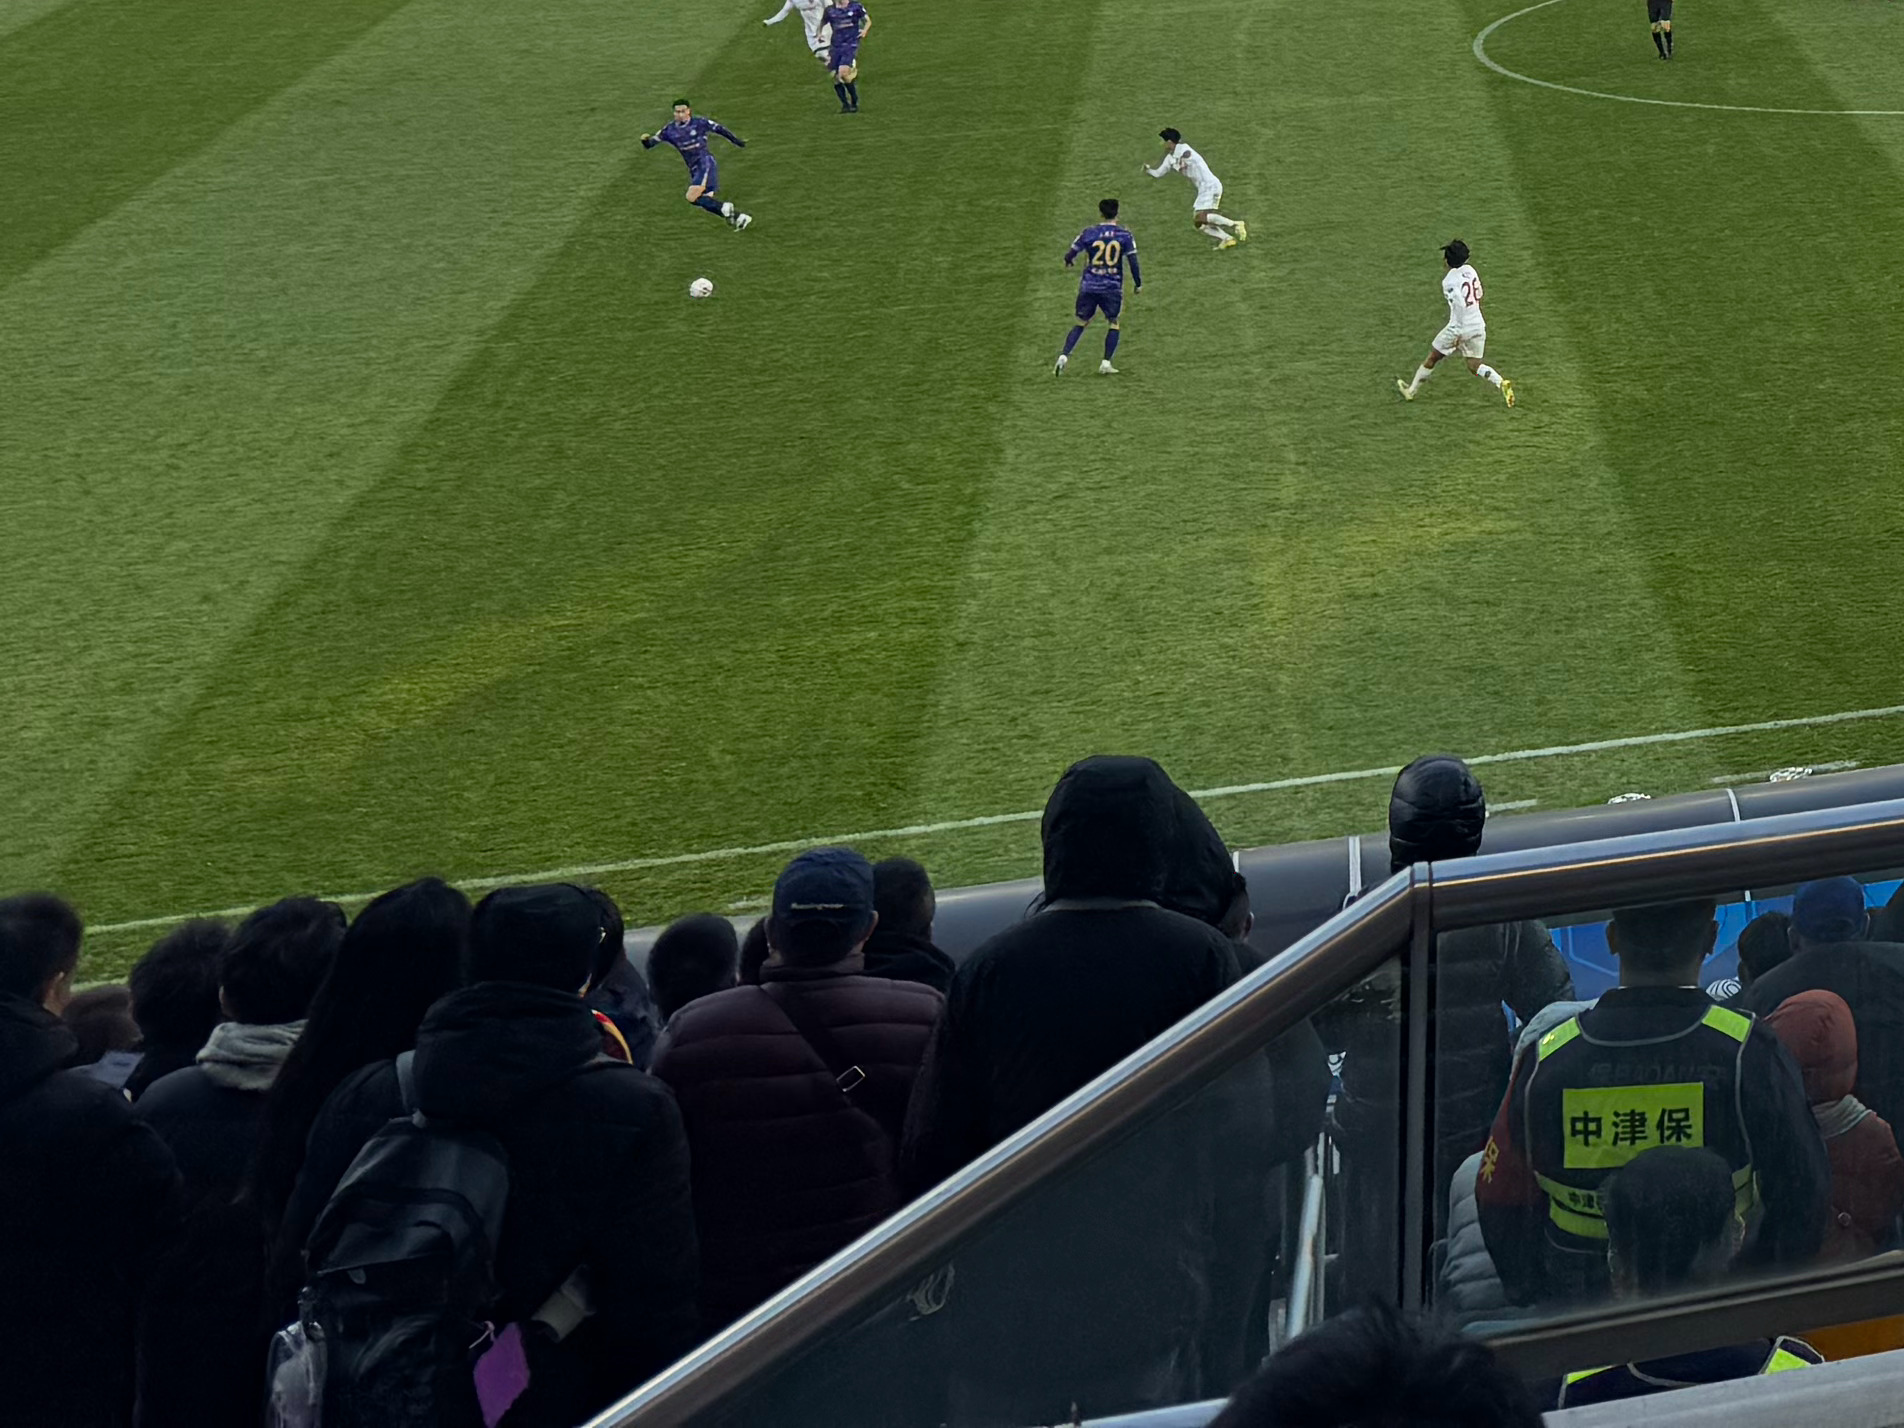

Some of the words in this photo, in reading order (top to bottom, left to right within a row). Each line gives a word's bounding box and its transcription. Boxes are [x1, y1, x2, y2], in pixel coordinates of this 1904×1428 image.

[1091, 239, 1122, 267] 20
[1568, 1106, 1693, 1149] 中津保
